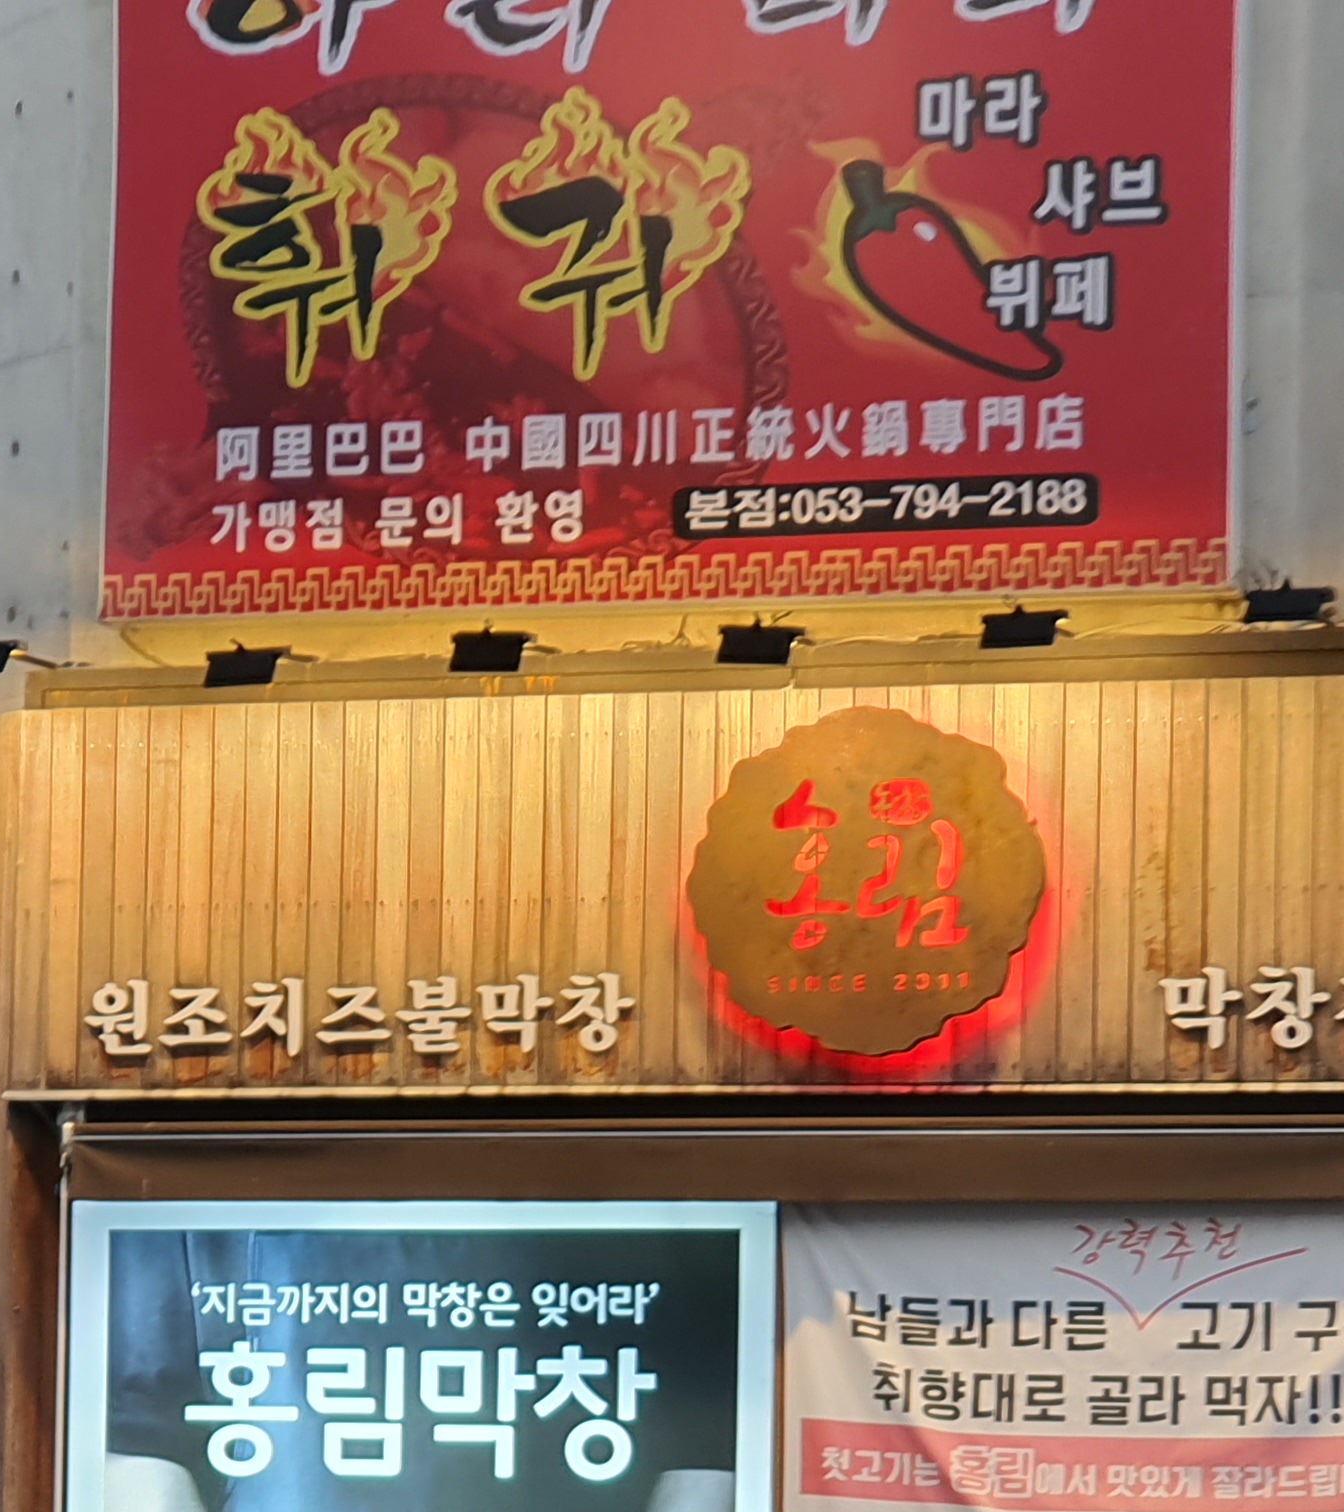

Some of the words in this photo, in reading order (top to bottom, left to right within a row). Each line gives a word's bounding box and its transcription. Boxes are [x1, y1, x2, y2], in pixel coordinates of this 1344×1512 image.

[918, 72, 1044, 148] 마라
[1032, 158, 1164, 232] 샤브
[986, 258, 1112, 332] 뷔페
[214, 418, 426, 482] 阿里巴巴
[210, 501, 346, 554] 가맹점
[374, 496, 464, 546] 문의
[494, 489, 585, 543] 환영
[684, 476, 1089, 530] 본점:053-794-2188
[765, 779, 968, 950] 홍림
[84, 972, 636, 1057] 원조치즈불막창
[768, 974, 868, 993] SINCE
[403, 1283, 521, 1328] 막창은
[847, 1292, 993, 1349] 남들과
[1011, 1299, 1109, 1352] 다른
[1177, 1300, 1273, 1352] 고기
[183, 1341, 657, 1482] 홍림막창
[872, 1363, 1067, 1424] 취향대로
[1088, 1373, 1186, 1427] 골라
[821, 1445, 941, 1487] 첫고기는
[950, 1443, 1098, 1499] 홍림에서
[1106, 1463, 1203, 1500] 맛있게
